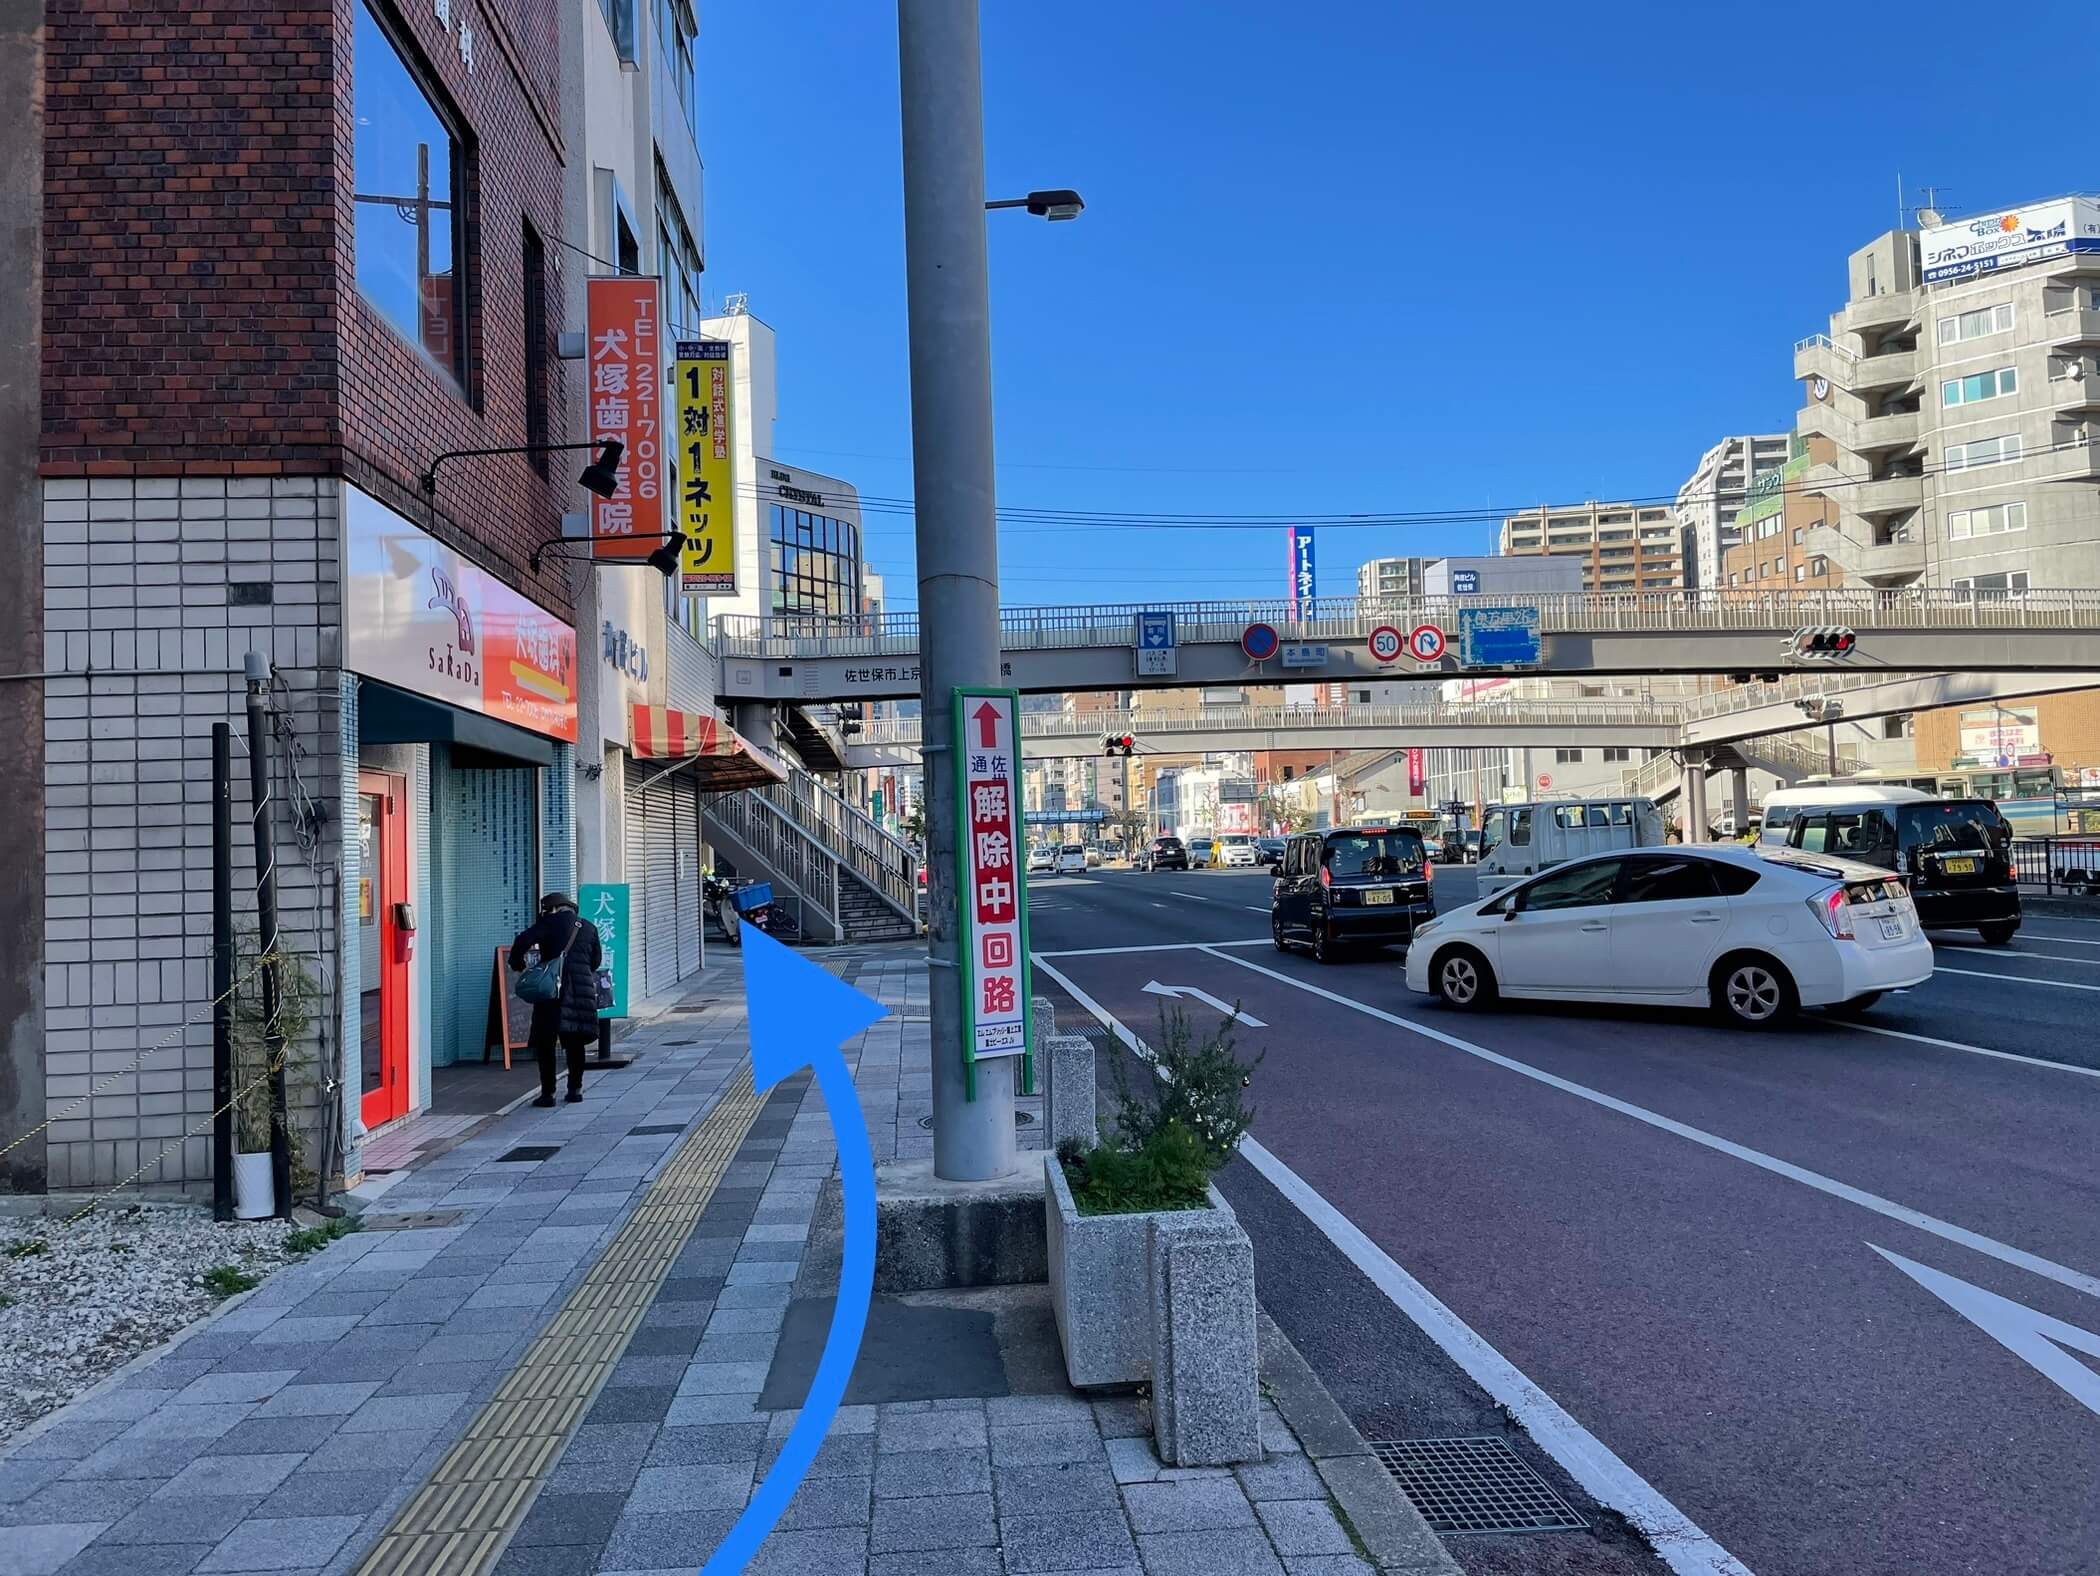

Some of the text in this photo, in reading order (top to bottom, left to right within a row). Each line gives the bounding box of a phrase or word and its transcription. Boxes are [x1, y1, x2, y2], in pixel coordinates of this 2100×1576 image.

[684, 366, 713, 568] 1対1ネッツ
[1375, 636, 1396, 652] 50
[845, 667, 921, 683] 佐世保市上京
[972, 755, 987, 773] 通
[973, 785, 1011, 914] 解除中
[982, 932, 1016, 1015] 回路
